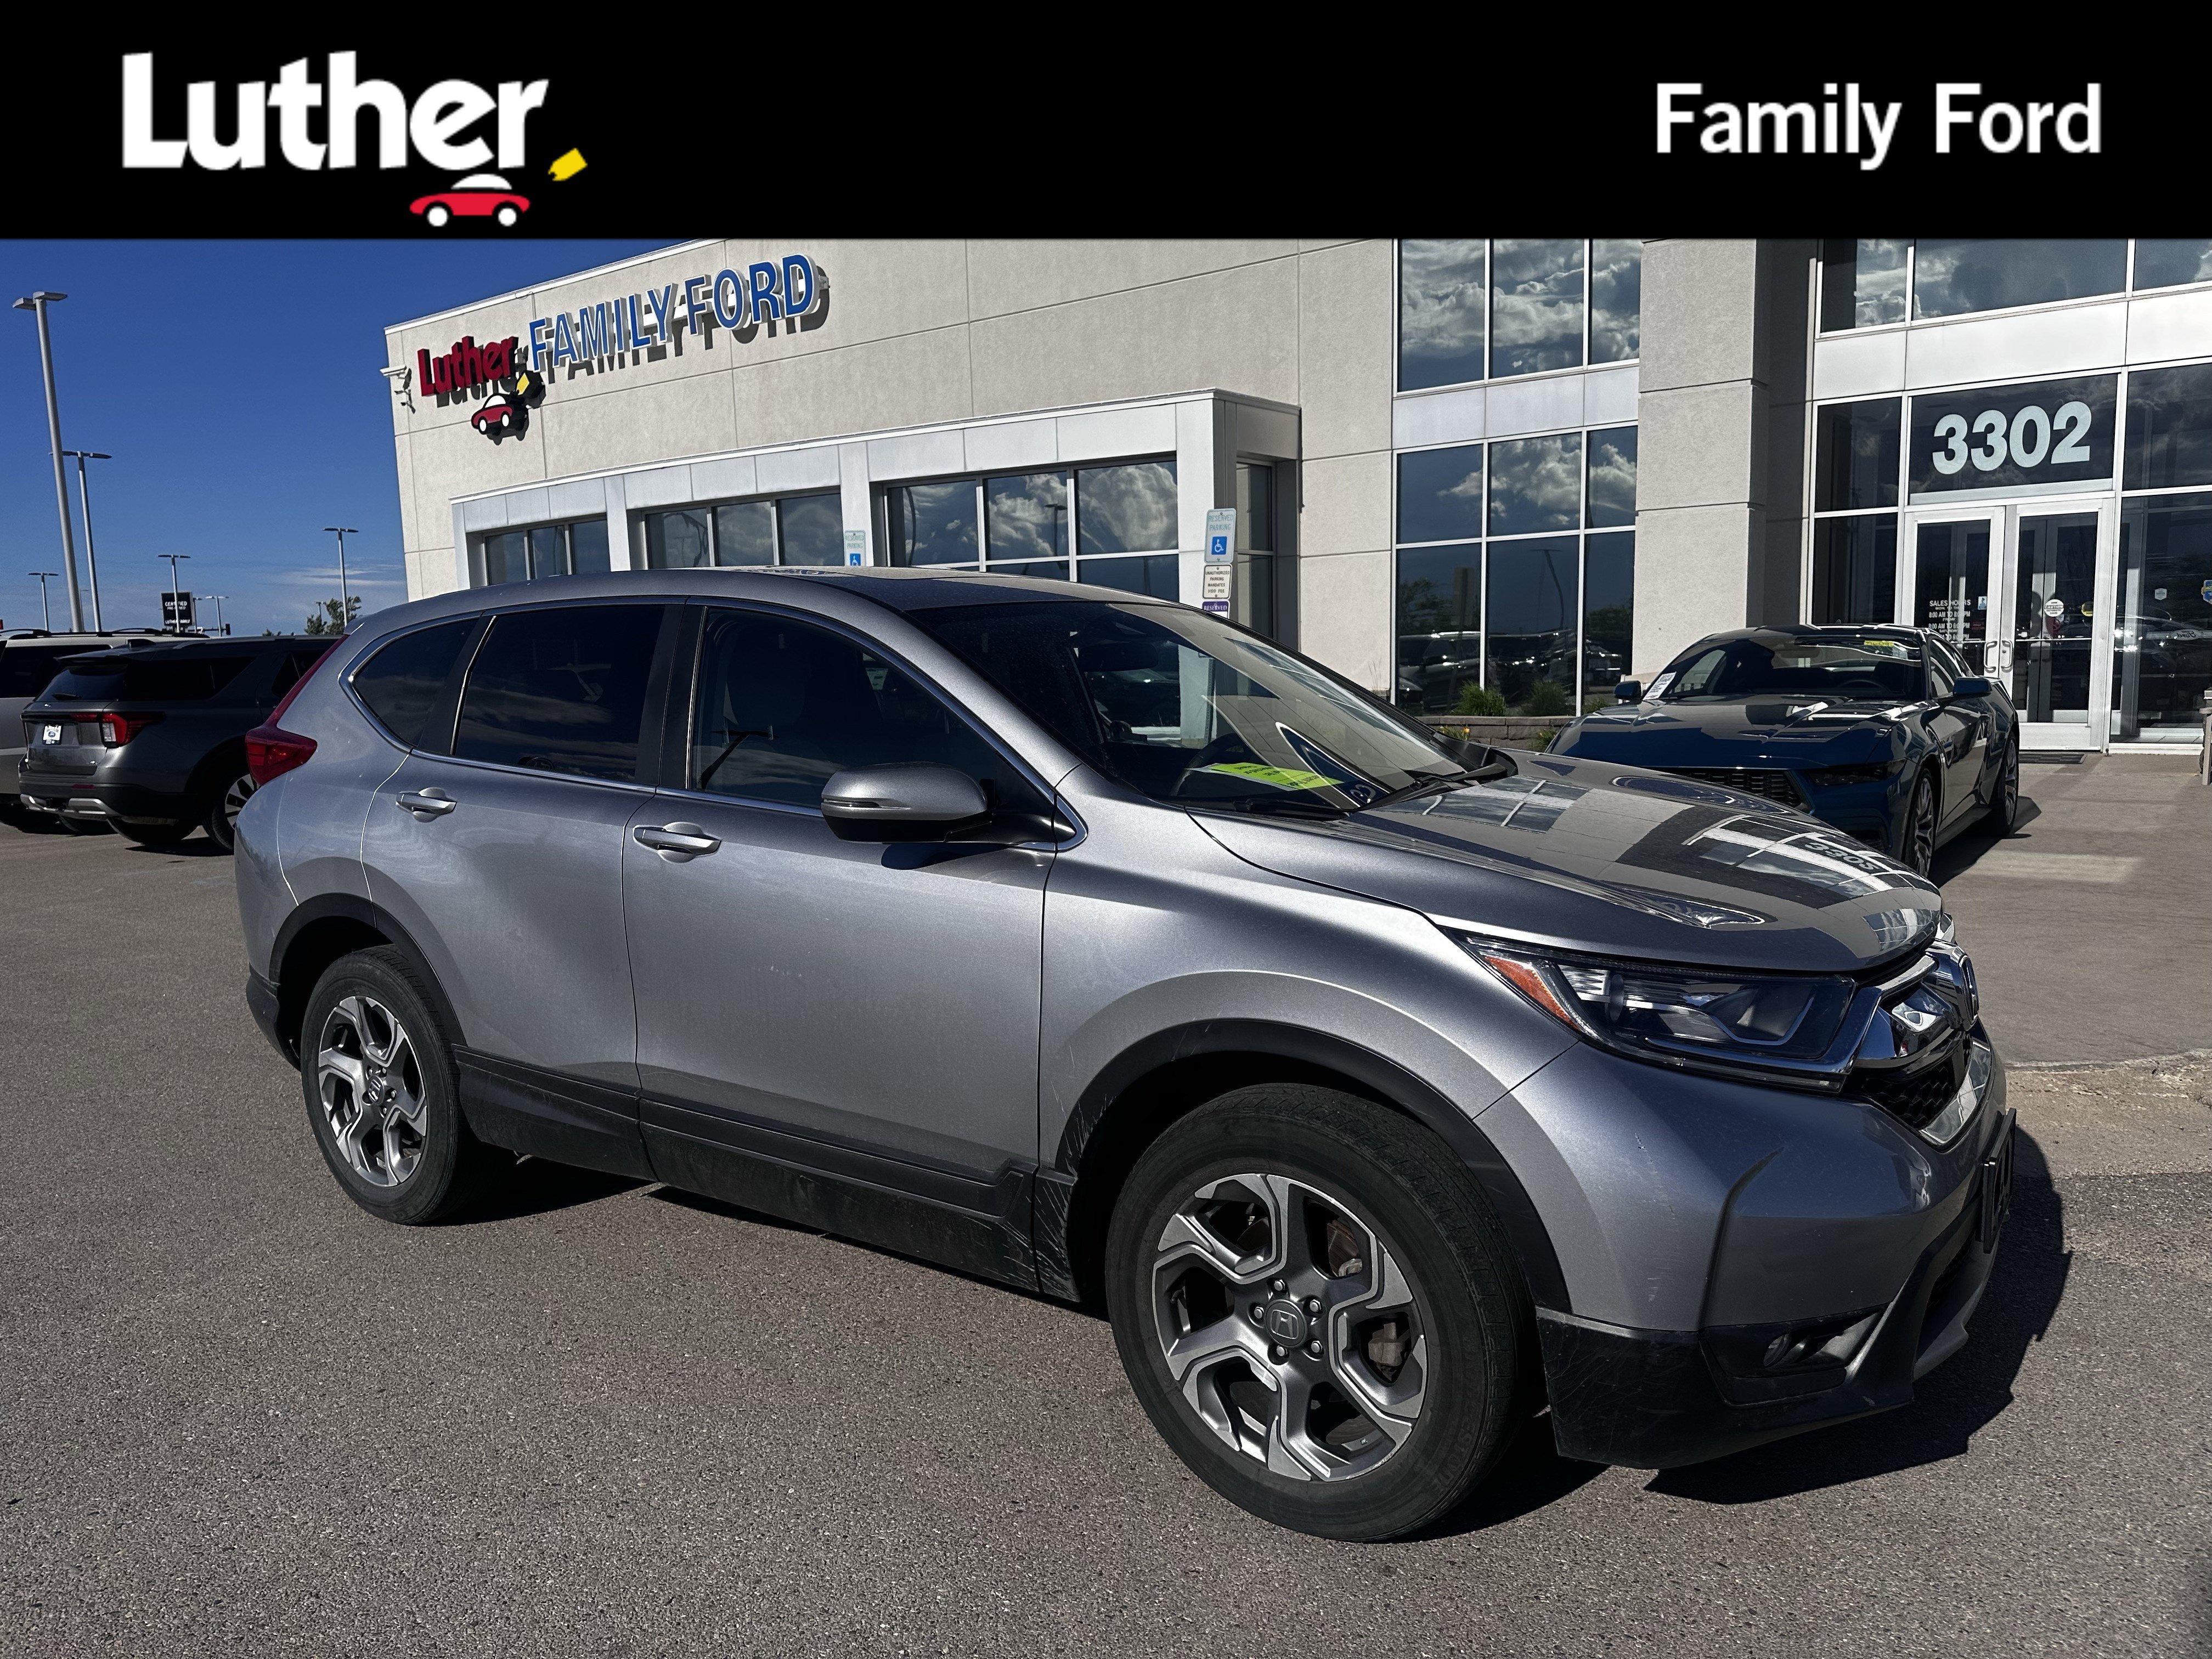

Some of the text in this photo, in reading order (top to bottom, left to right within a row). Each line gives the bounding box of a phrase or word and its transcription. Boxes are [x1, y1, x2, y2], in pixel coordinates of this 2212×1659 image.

[528, 253, 820, 373] FAMILY FORD
[417, 336, 519, 397] Luther
[1932, 401, 2092, 475] 3302
